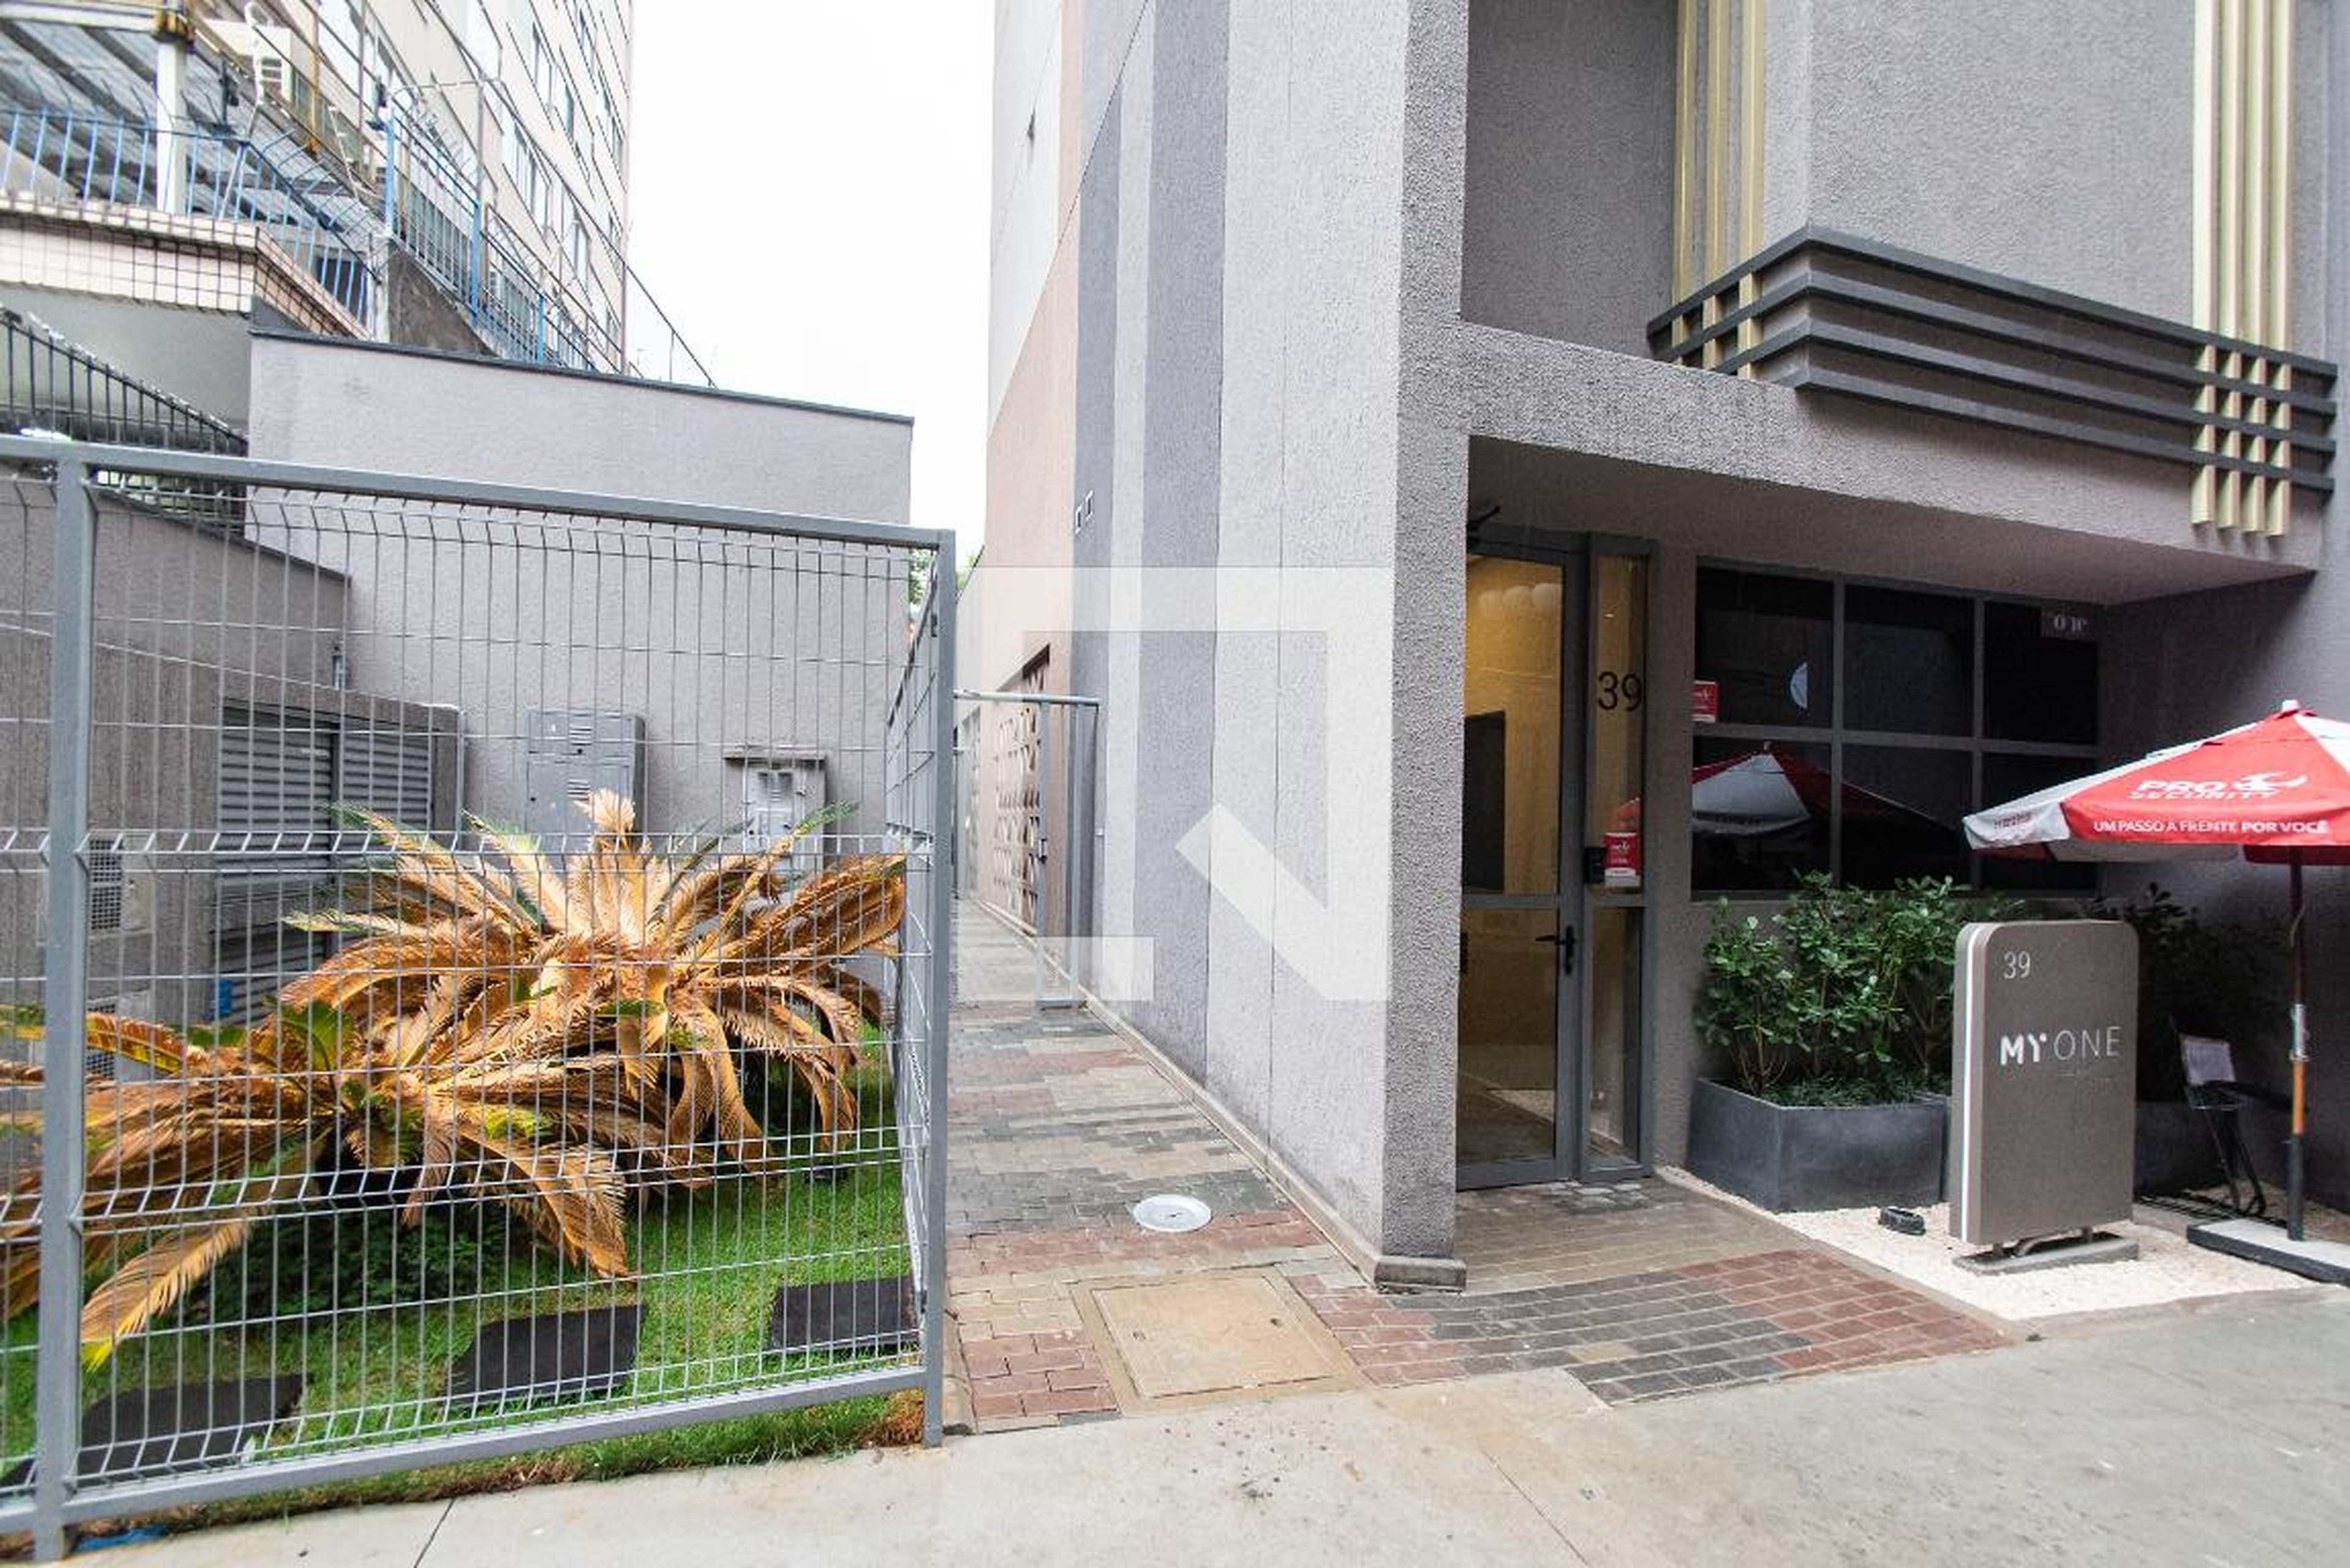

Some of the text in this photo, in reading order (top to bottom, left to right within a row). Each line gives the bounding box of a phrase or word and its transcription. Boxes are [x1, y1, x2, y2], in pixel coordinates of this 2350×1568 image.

[1597, 670, 1643, 712] 39
[2137, 780, 2227, 792] PRO
[2094, 821, 2116, 832] UM
[2118, 820, 2164, 832] PASSO
[2165, 821, 2178, 832] A
[2241, 821, 2278, 833] POR
[2004, 950, 2031, 979] 39
[2000, 1026, 2121, 1066] MY ONE
